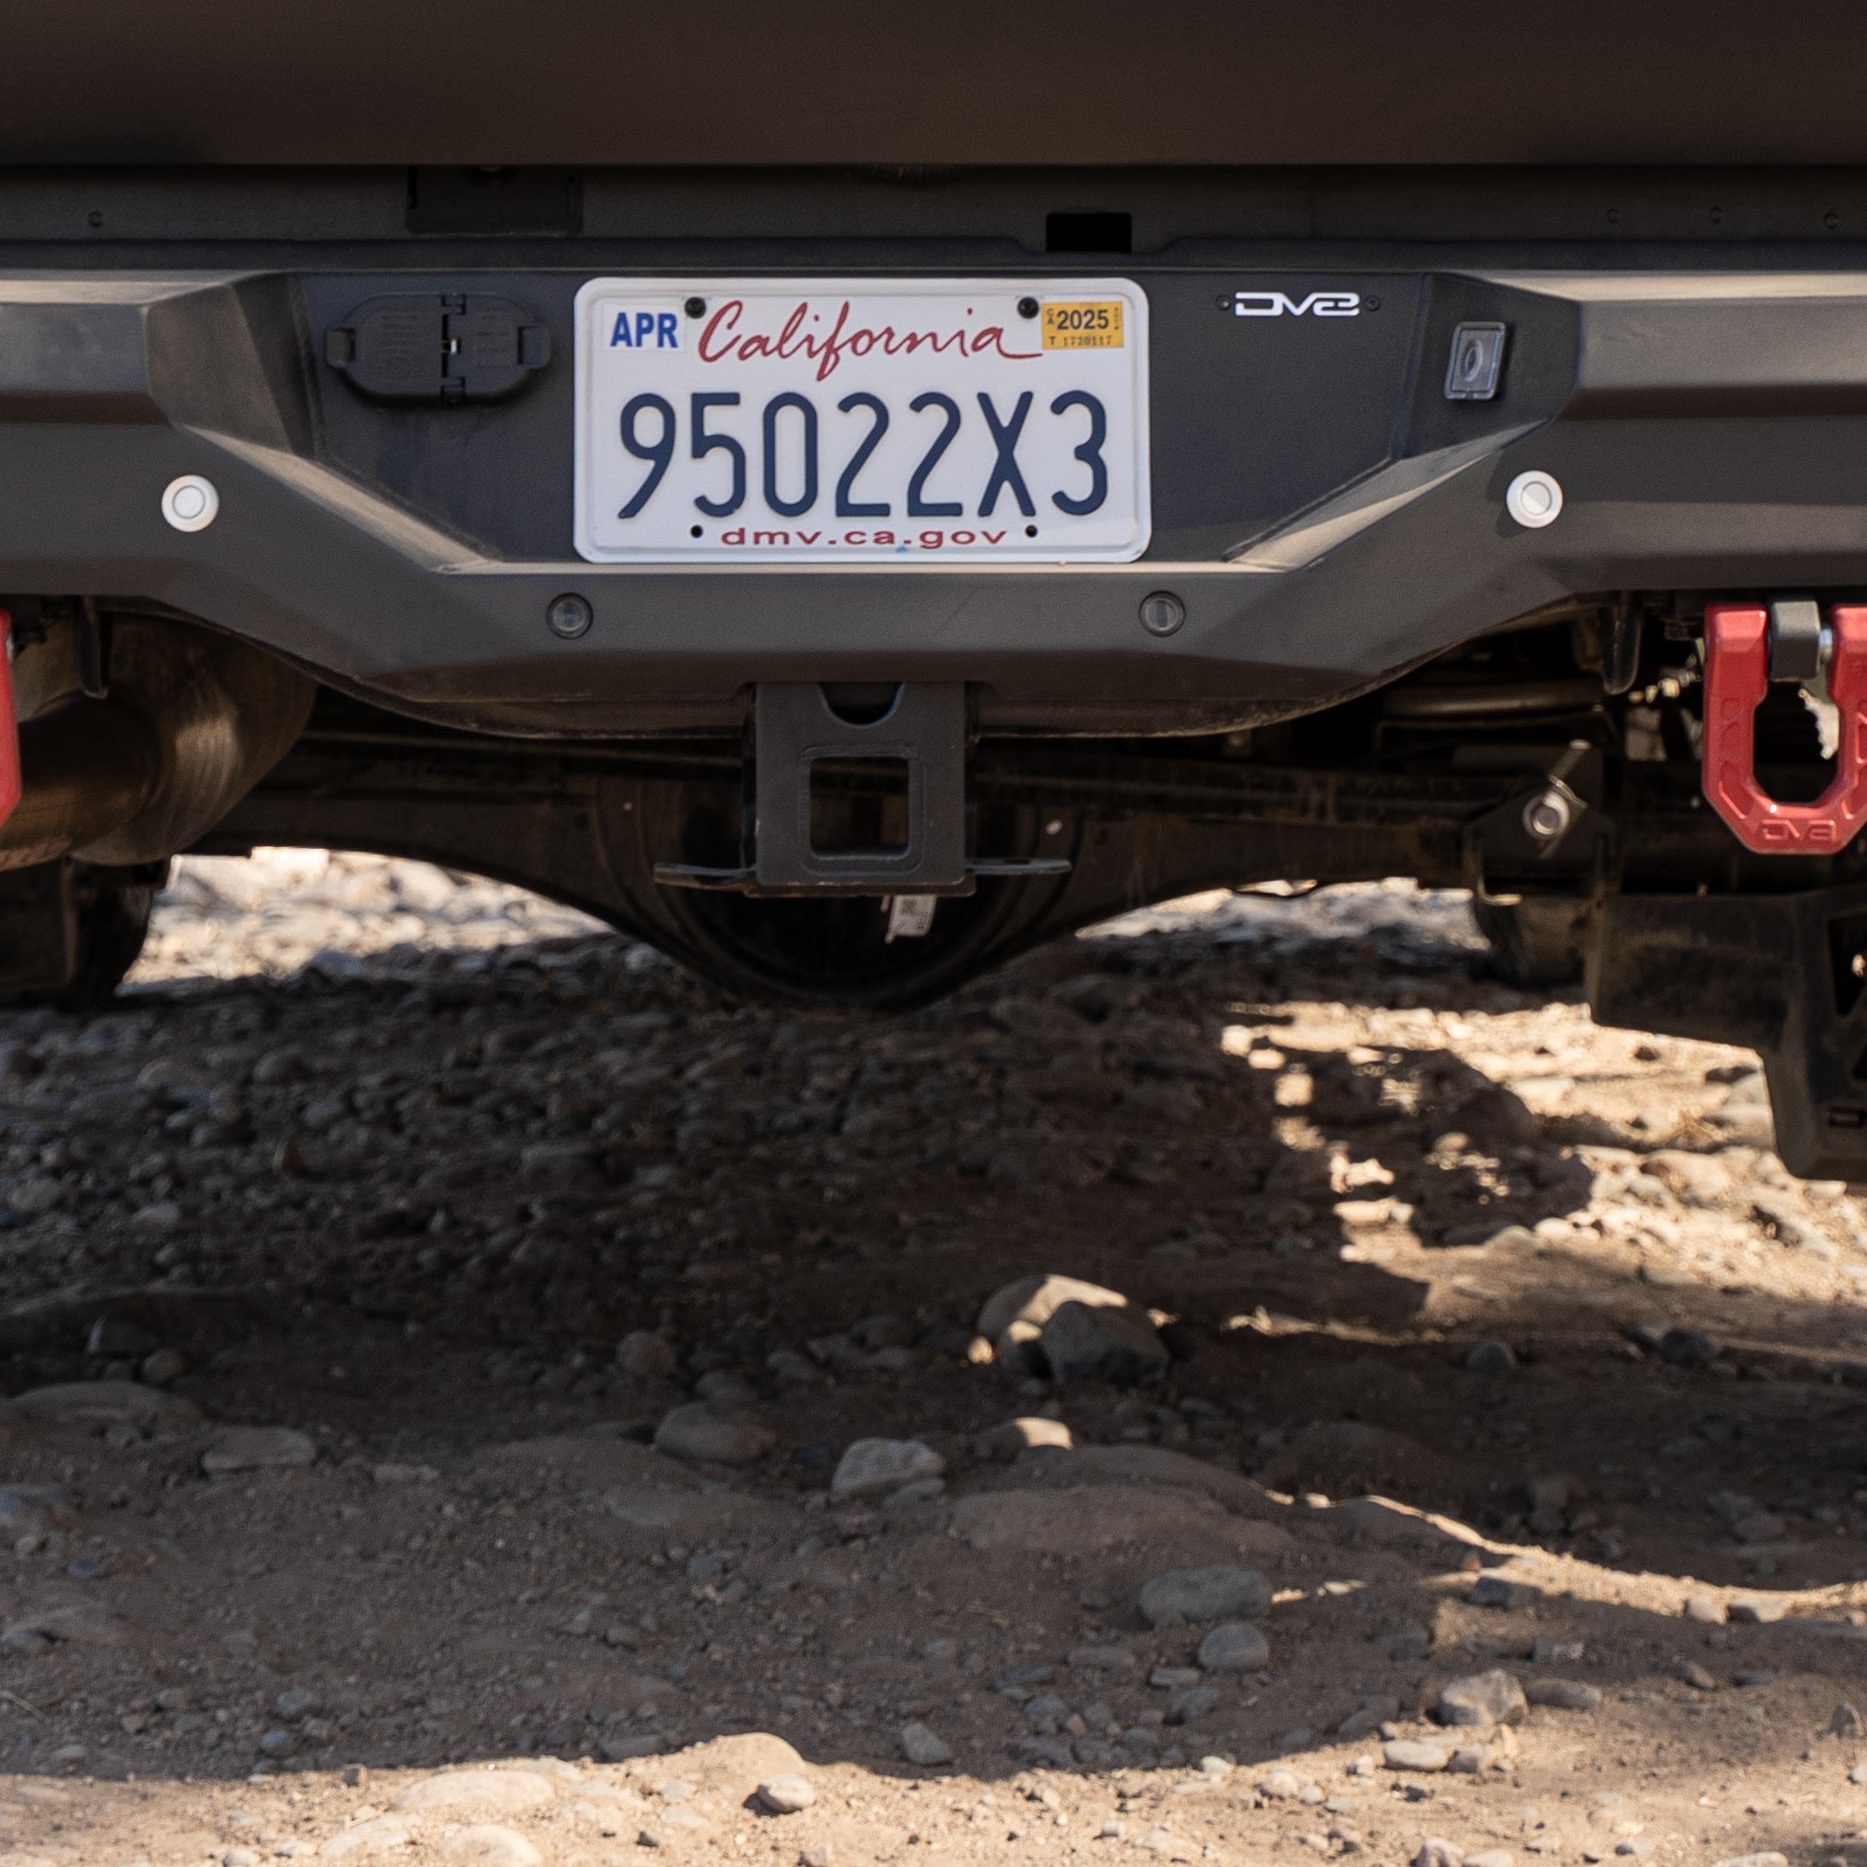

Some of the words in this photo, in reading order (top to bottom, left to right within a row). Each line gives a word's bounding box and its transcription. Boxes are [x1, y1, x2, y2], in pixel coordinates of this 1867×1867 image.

[610, 311, 679, 348] APR
[1056, 309, 1109, 330] 2025
[698, 300, 1043, 382] California
[618, 389, 1108, 519] 95022X3
[721, 527, 1008, 550] dmv.ca.gov
